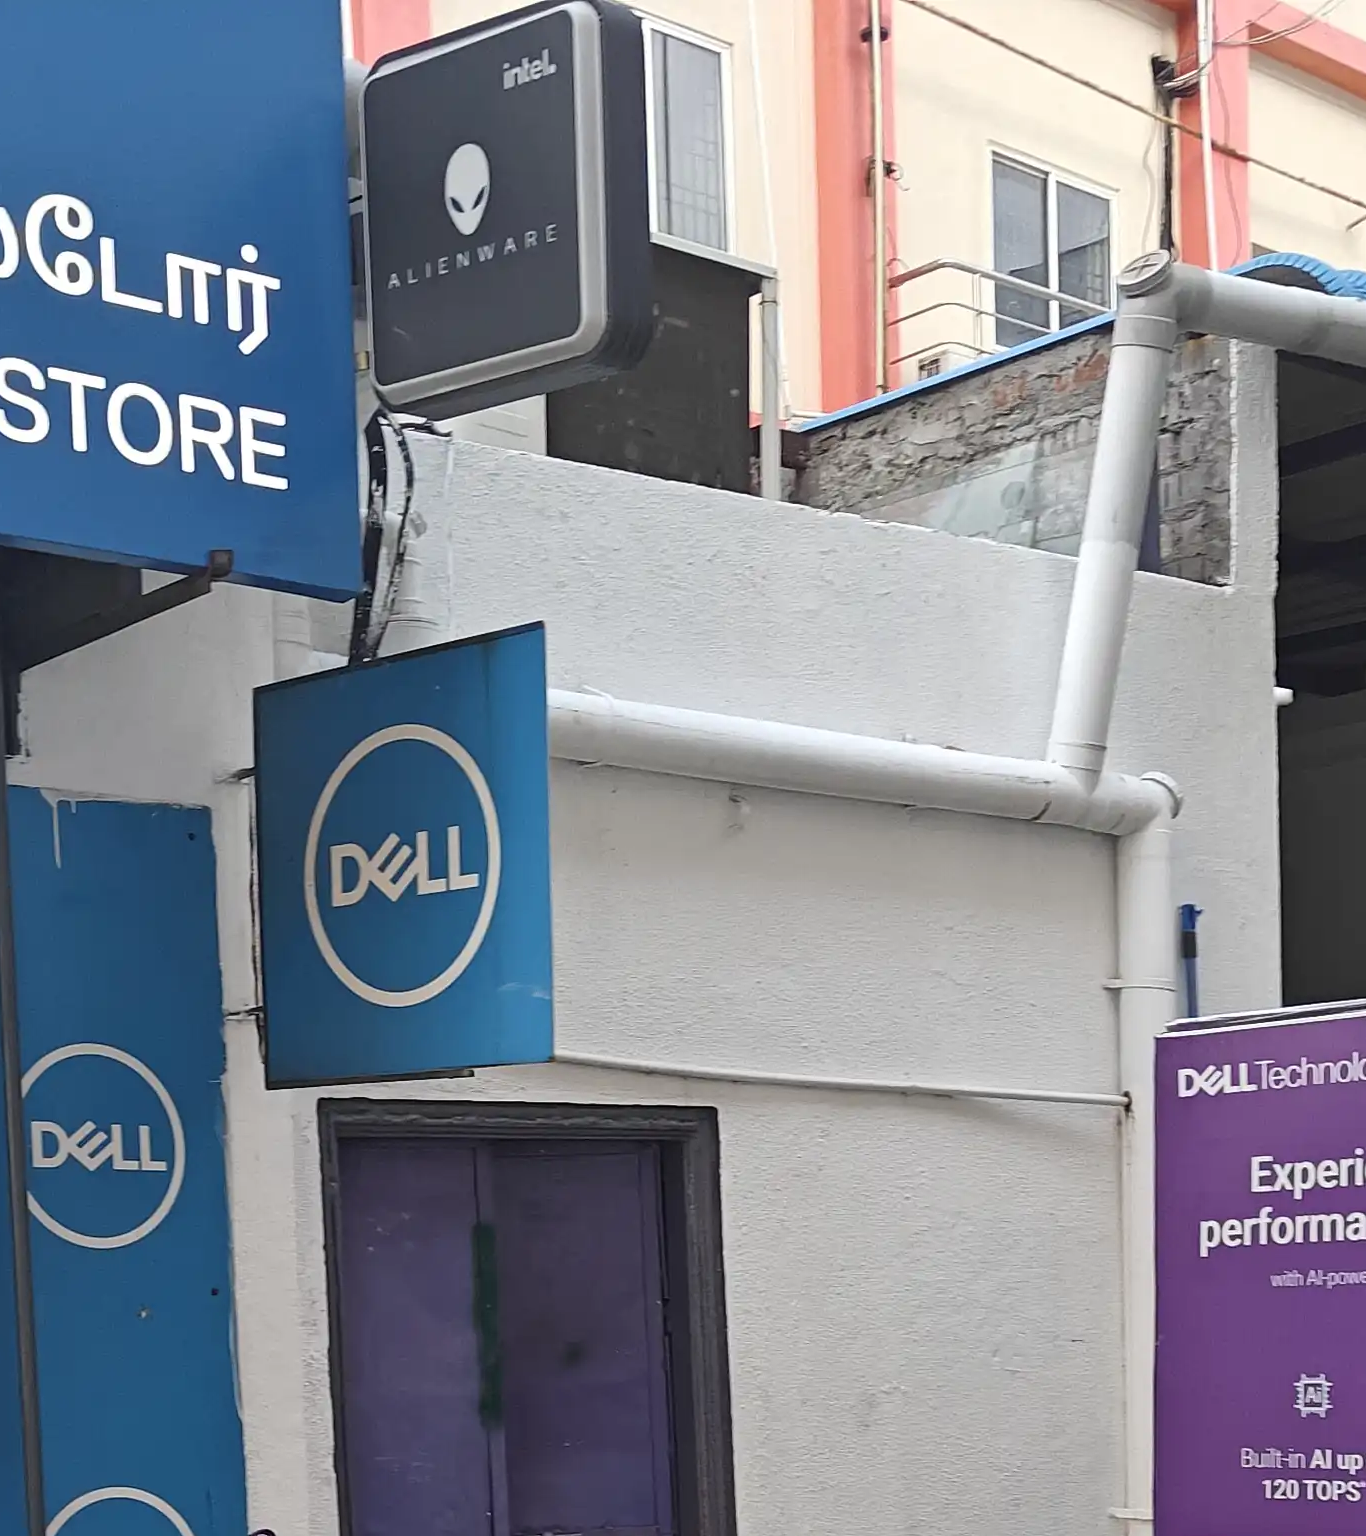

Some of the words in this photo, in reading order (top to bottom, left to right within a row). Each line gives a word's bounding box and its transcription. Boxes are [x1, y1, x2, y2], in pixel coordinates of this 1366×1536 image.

[388, 224, 559, 290] ALIENWARE
[329, 825, 479, 907] DELL
[31, 1120, 167, 1170] DELL
[1270, 1270, 1304, 1288] with
[1240, 1448, 1306, 1469] Built-in
[1309, 1449, 1333, 1470] AI
[1337, 1453, 1364, 1475] up
[1262, 1479, 1300, 1500] 120
